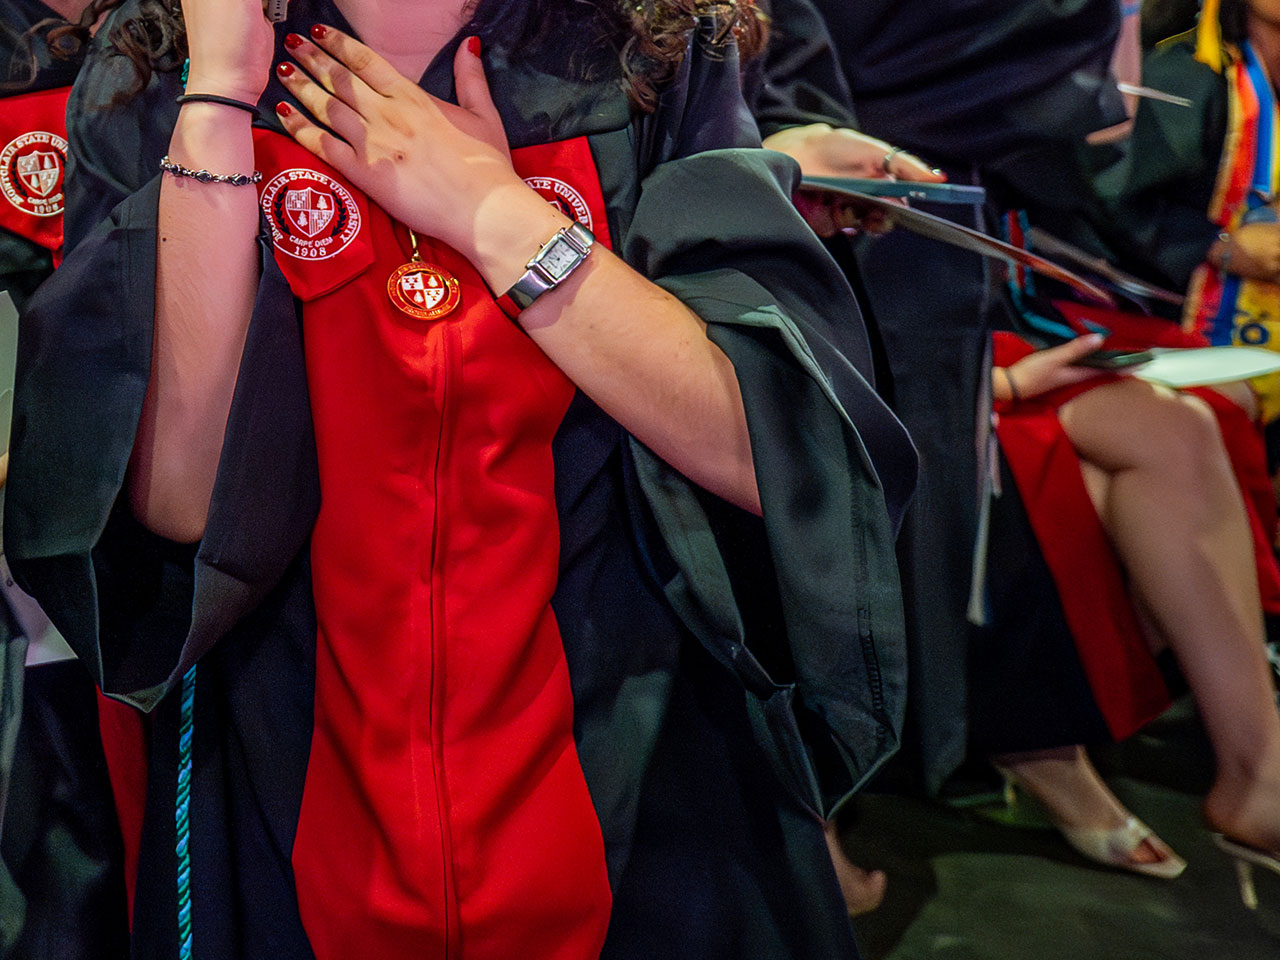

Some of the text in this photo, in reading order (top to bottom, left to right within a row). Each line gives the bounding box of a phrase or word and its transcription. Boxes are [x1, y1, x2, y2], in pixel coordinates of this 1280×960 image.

[16, 134, 50, 148] STATE
[289, 171, 328, 185] STATE
[329, 182, 359, 243] UNIVERSITY
[289, 235, 333, 248] CARPE DIEM
[294, 246, 327, 257] 1908
